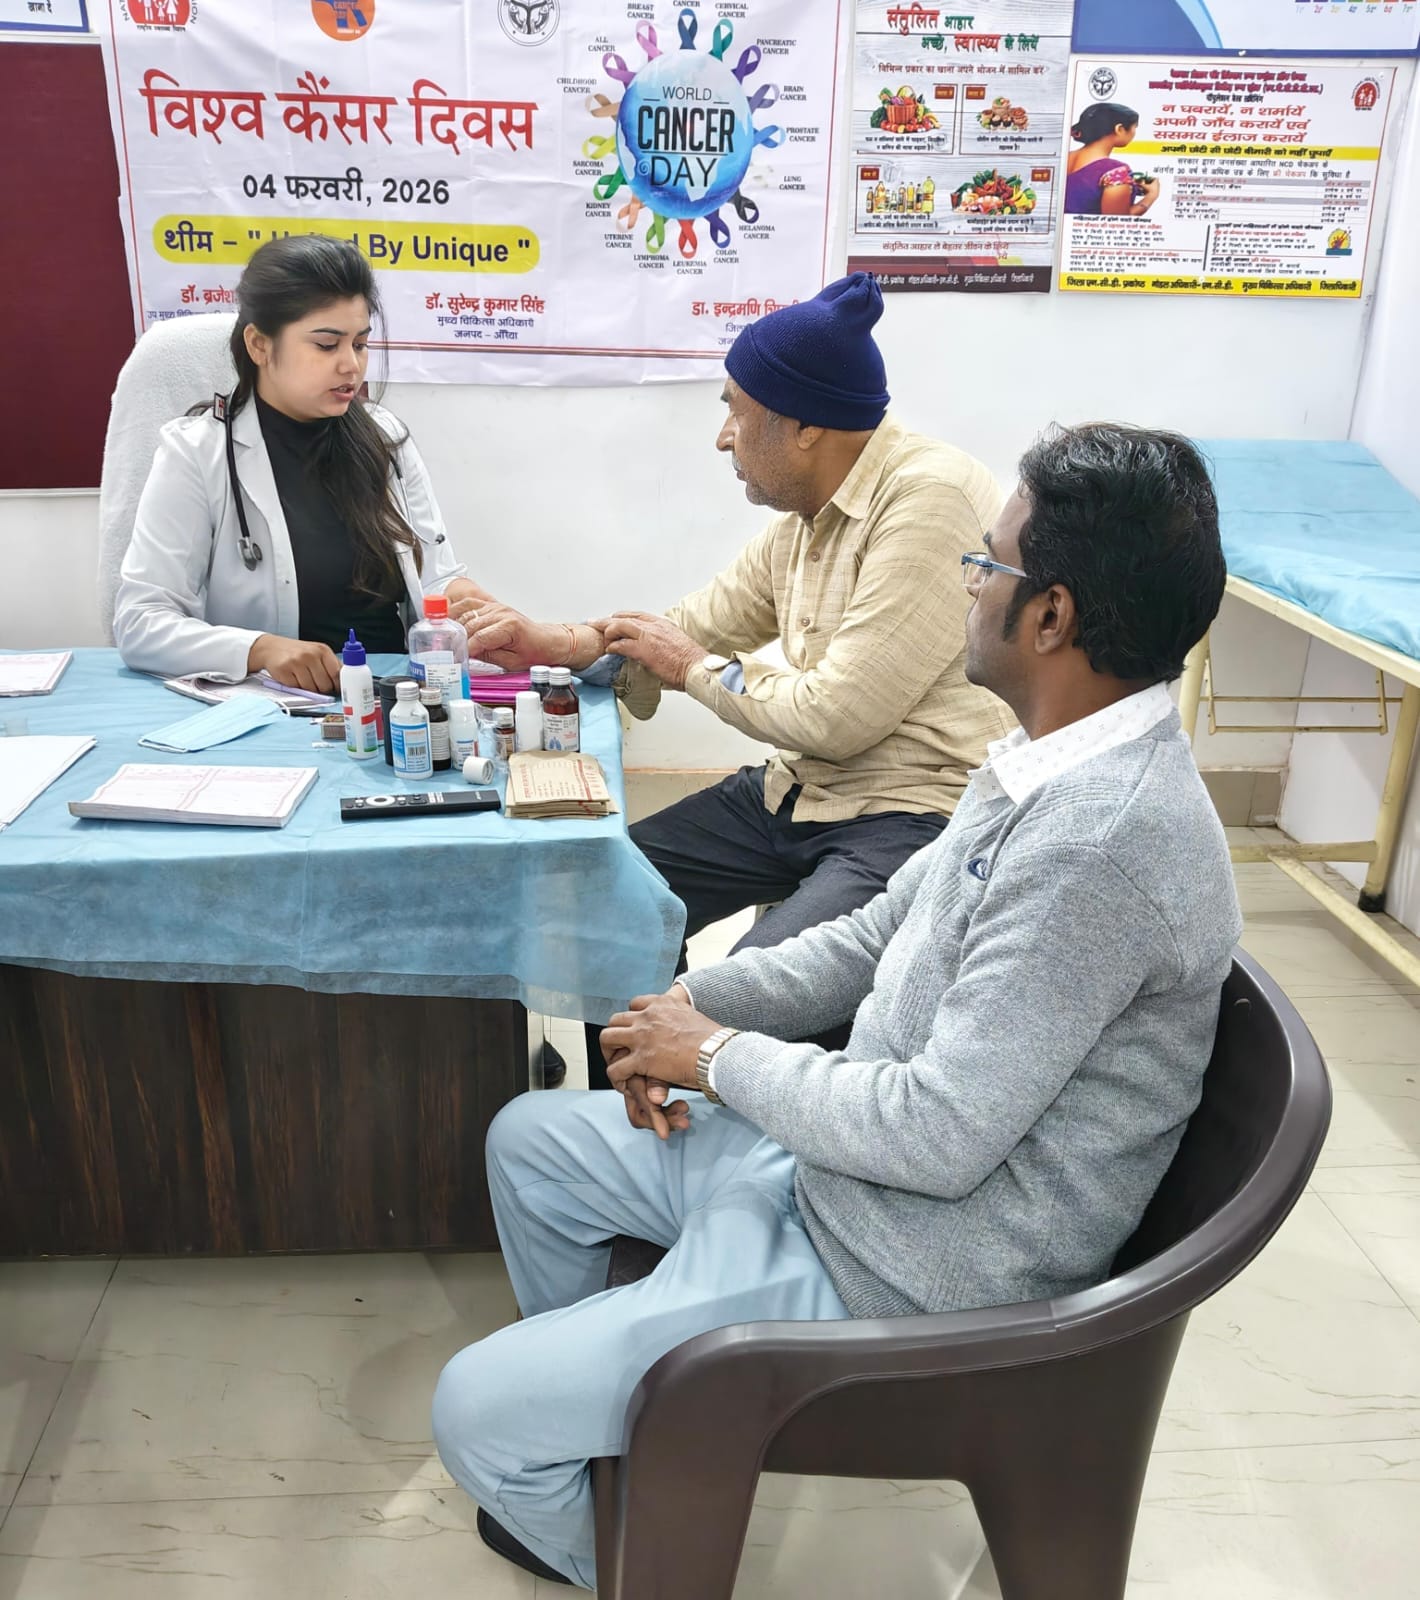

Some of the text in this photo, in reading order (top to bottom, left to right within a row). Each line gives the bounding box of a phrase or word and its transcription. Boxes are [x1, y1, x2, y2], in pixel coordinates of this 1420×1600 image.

[887, 1, 974, 36] संतुलित आहार
[756, 38, 797, 47] PANCREATIC
[954, 33, 1001, 53] स्वास्थ्य
[662, 85, 712, 101] WORLD
[783, 85, 804, 93] BRAIN
[138, 68, 539, 156] विश्व कैंसर दिवस
[1162, 104, 1176, 113] न
[1240, 106, 1254, 115] न
[1152, 115, 1198, 127] अपनी
[637, 105, 735, 153] CANCER
[786, 126, 820, 134] PROSTATE
[1153, 130, 1208, 140] ससमय
[1161, 144, 1187, 153] अपनी
[572, 160, 605, 168] SARCOMA
[1280, 160, 1294, 168] NCD
[649, 155, 718, 188] DAY
[783, 175, 802, 183] LUNG
[243, 167, 450, 207] 04 फरवरी, 2026
[585, 202, 611, 210] KIDNEY
[164, 220, 213, 253] थीम
[369, 233, 403, 265] By
[413, 235, 509, 267] Unique
[180, 284, 200, 304] डॉ.
[425, 292, 546, 317] डॉ. सुरेन्द्र कुमार सिंह
[454, 329, 482, 339] जनपद
